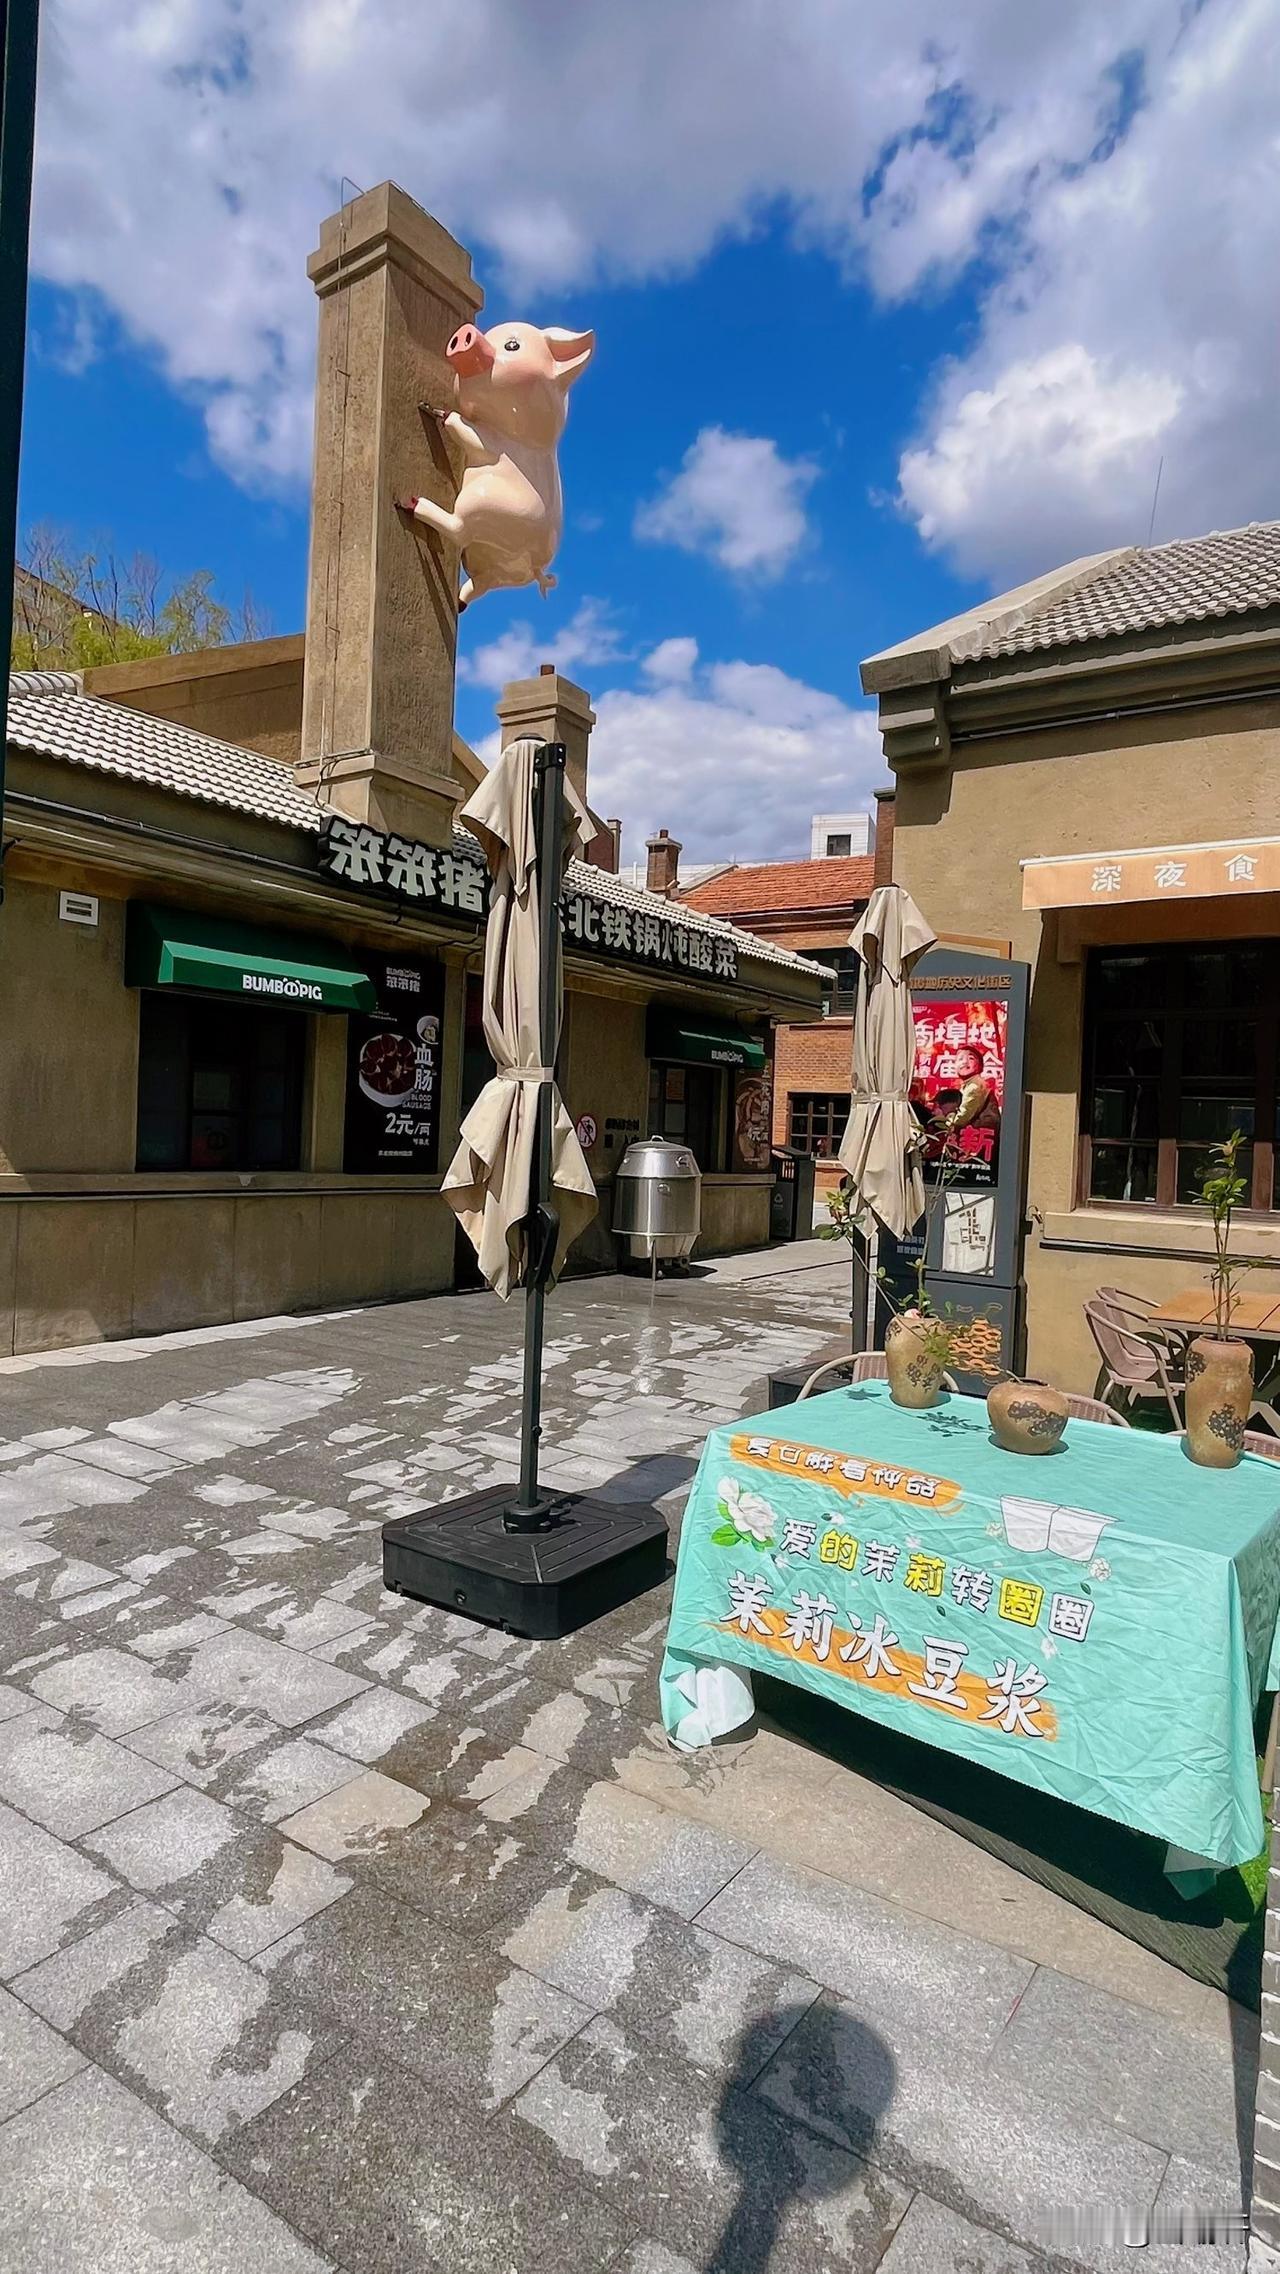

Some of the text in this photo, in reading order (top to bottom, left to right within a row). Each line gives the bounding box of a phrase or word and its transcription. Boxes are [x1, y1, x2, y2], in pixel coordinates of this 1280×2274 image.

[329, 820, 738, 979] 笨笨猪 北铁锅炖酸菜
[1090, 853, 1259, 892] 深夜食
[413, 1042, 435, 1092] 血肠
[778, 1518, 1095, 1641] 爱的茉莉转圈圈
[719, 1570, 1055, 1738] 茉莉冰豆浆
